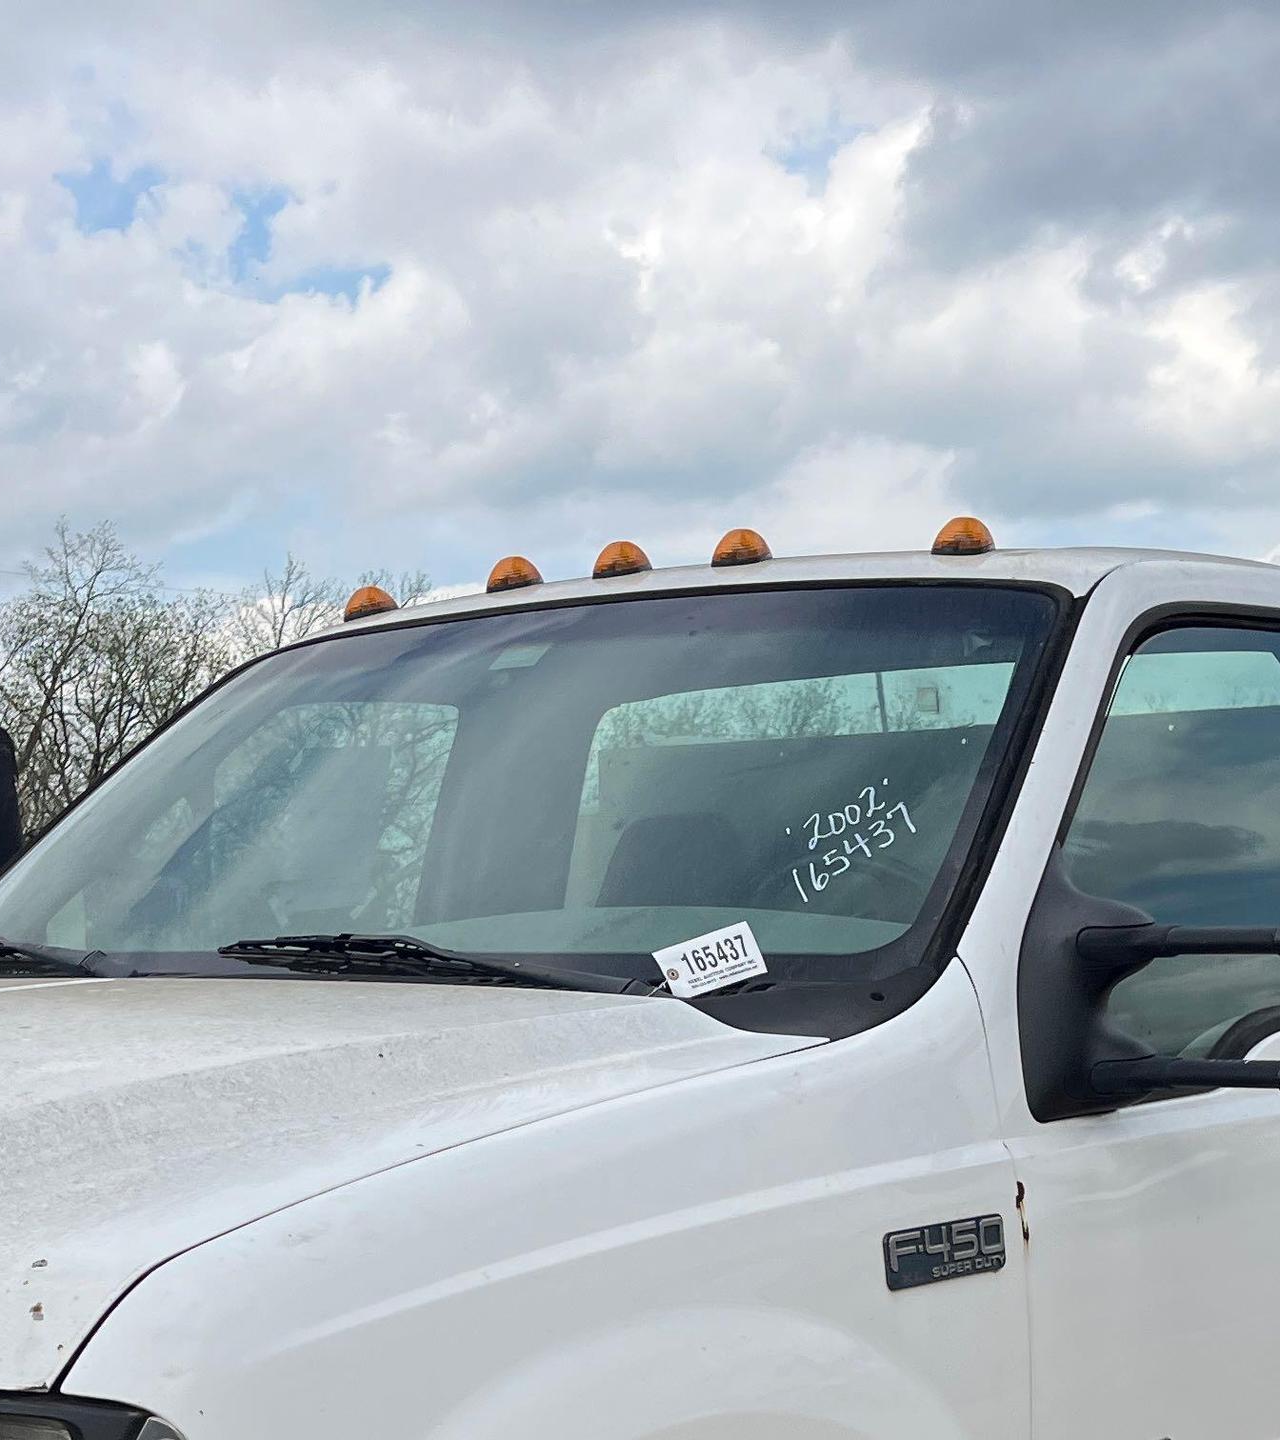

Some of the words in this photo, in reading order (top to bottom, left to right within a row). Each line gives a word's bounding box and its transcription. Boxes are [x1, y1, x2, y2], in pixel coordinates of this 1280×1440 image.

[792, 801, 917, 902] 165437
[680, 934, 748, 975] 165437
[932, 1260, 972, 1278] SUPER
